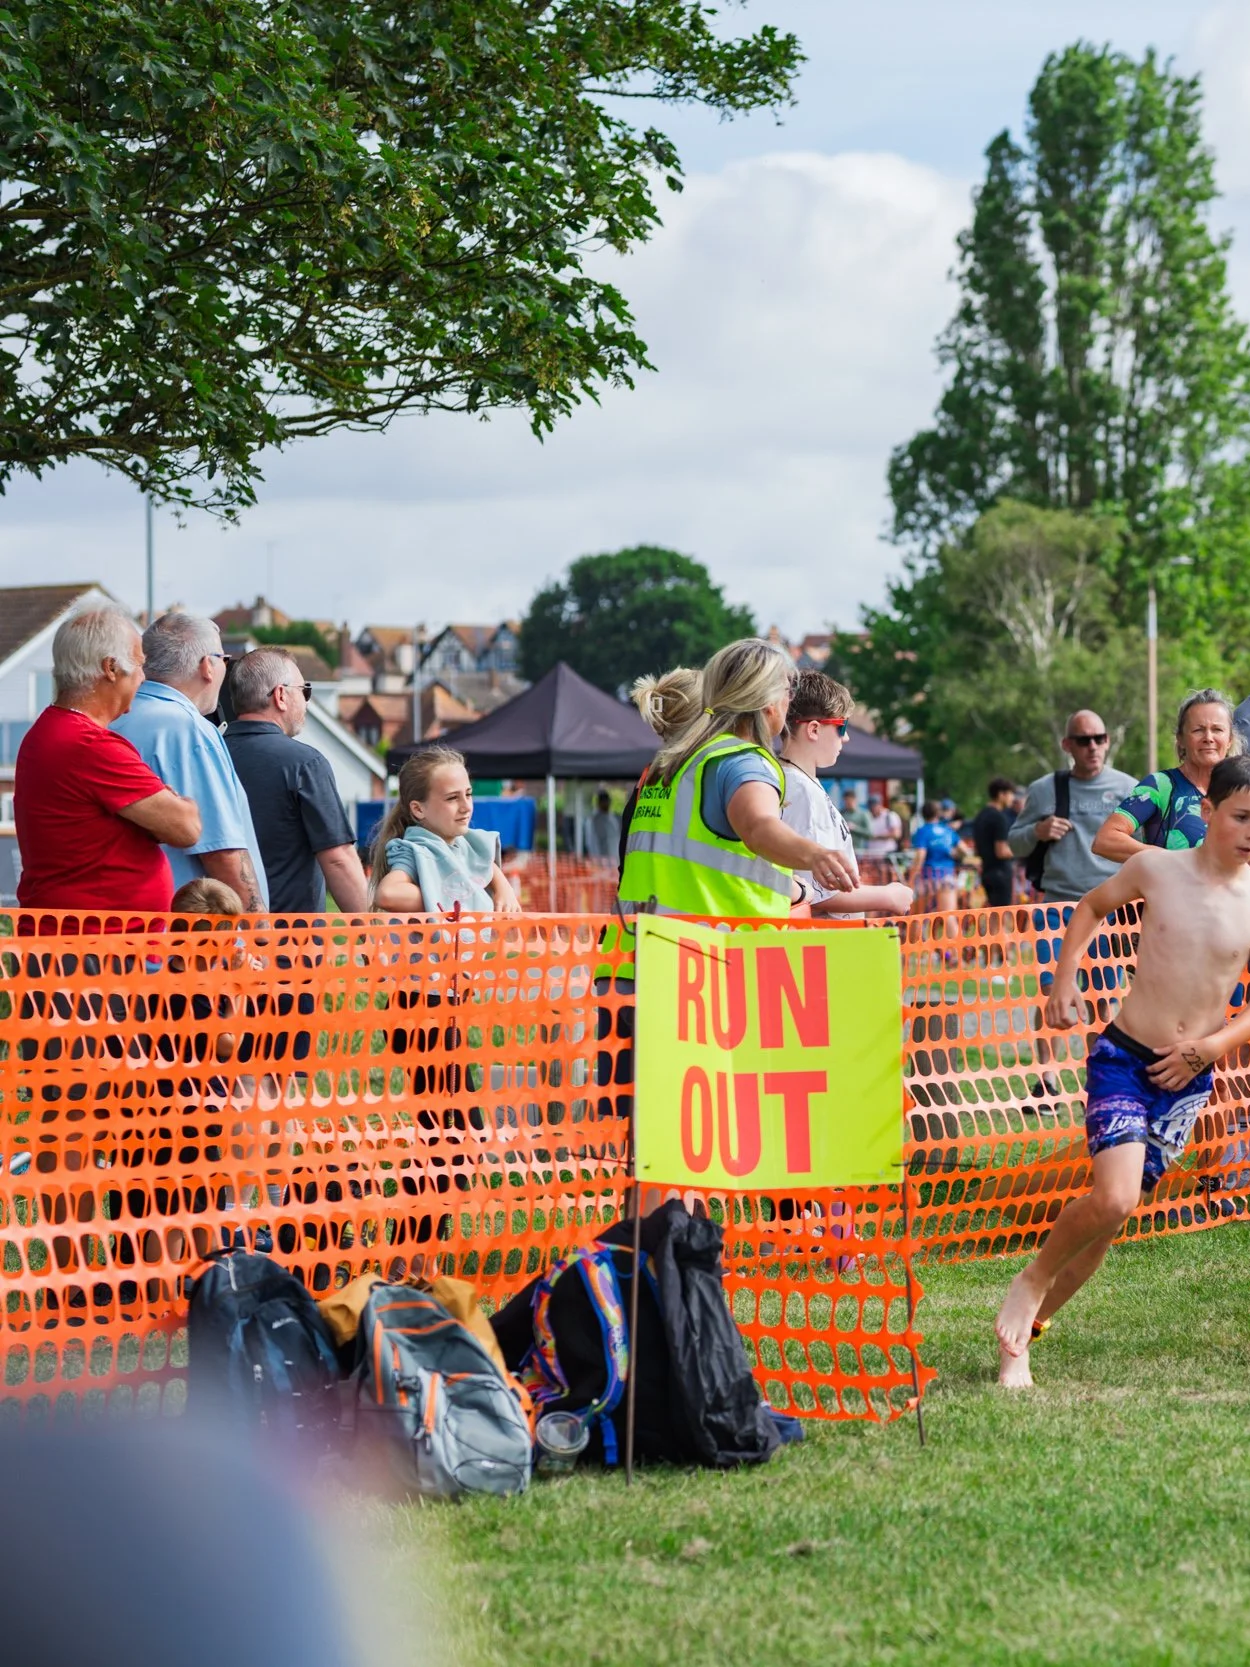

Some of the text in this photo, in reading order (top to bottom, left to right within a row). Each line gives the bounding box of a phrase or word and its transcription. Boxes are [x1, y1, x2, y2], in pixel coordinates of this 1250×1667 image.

[677, 936, 830, 1051] RUN
[1181, 1047, 1205, 1073] 225
[680, 1065, 828, 1177] OUT
